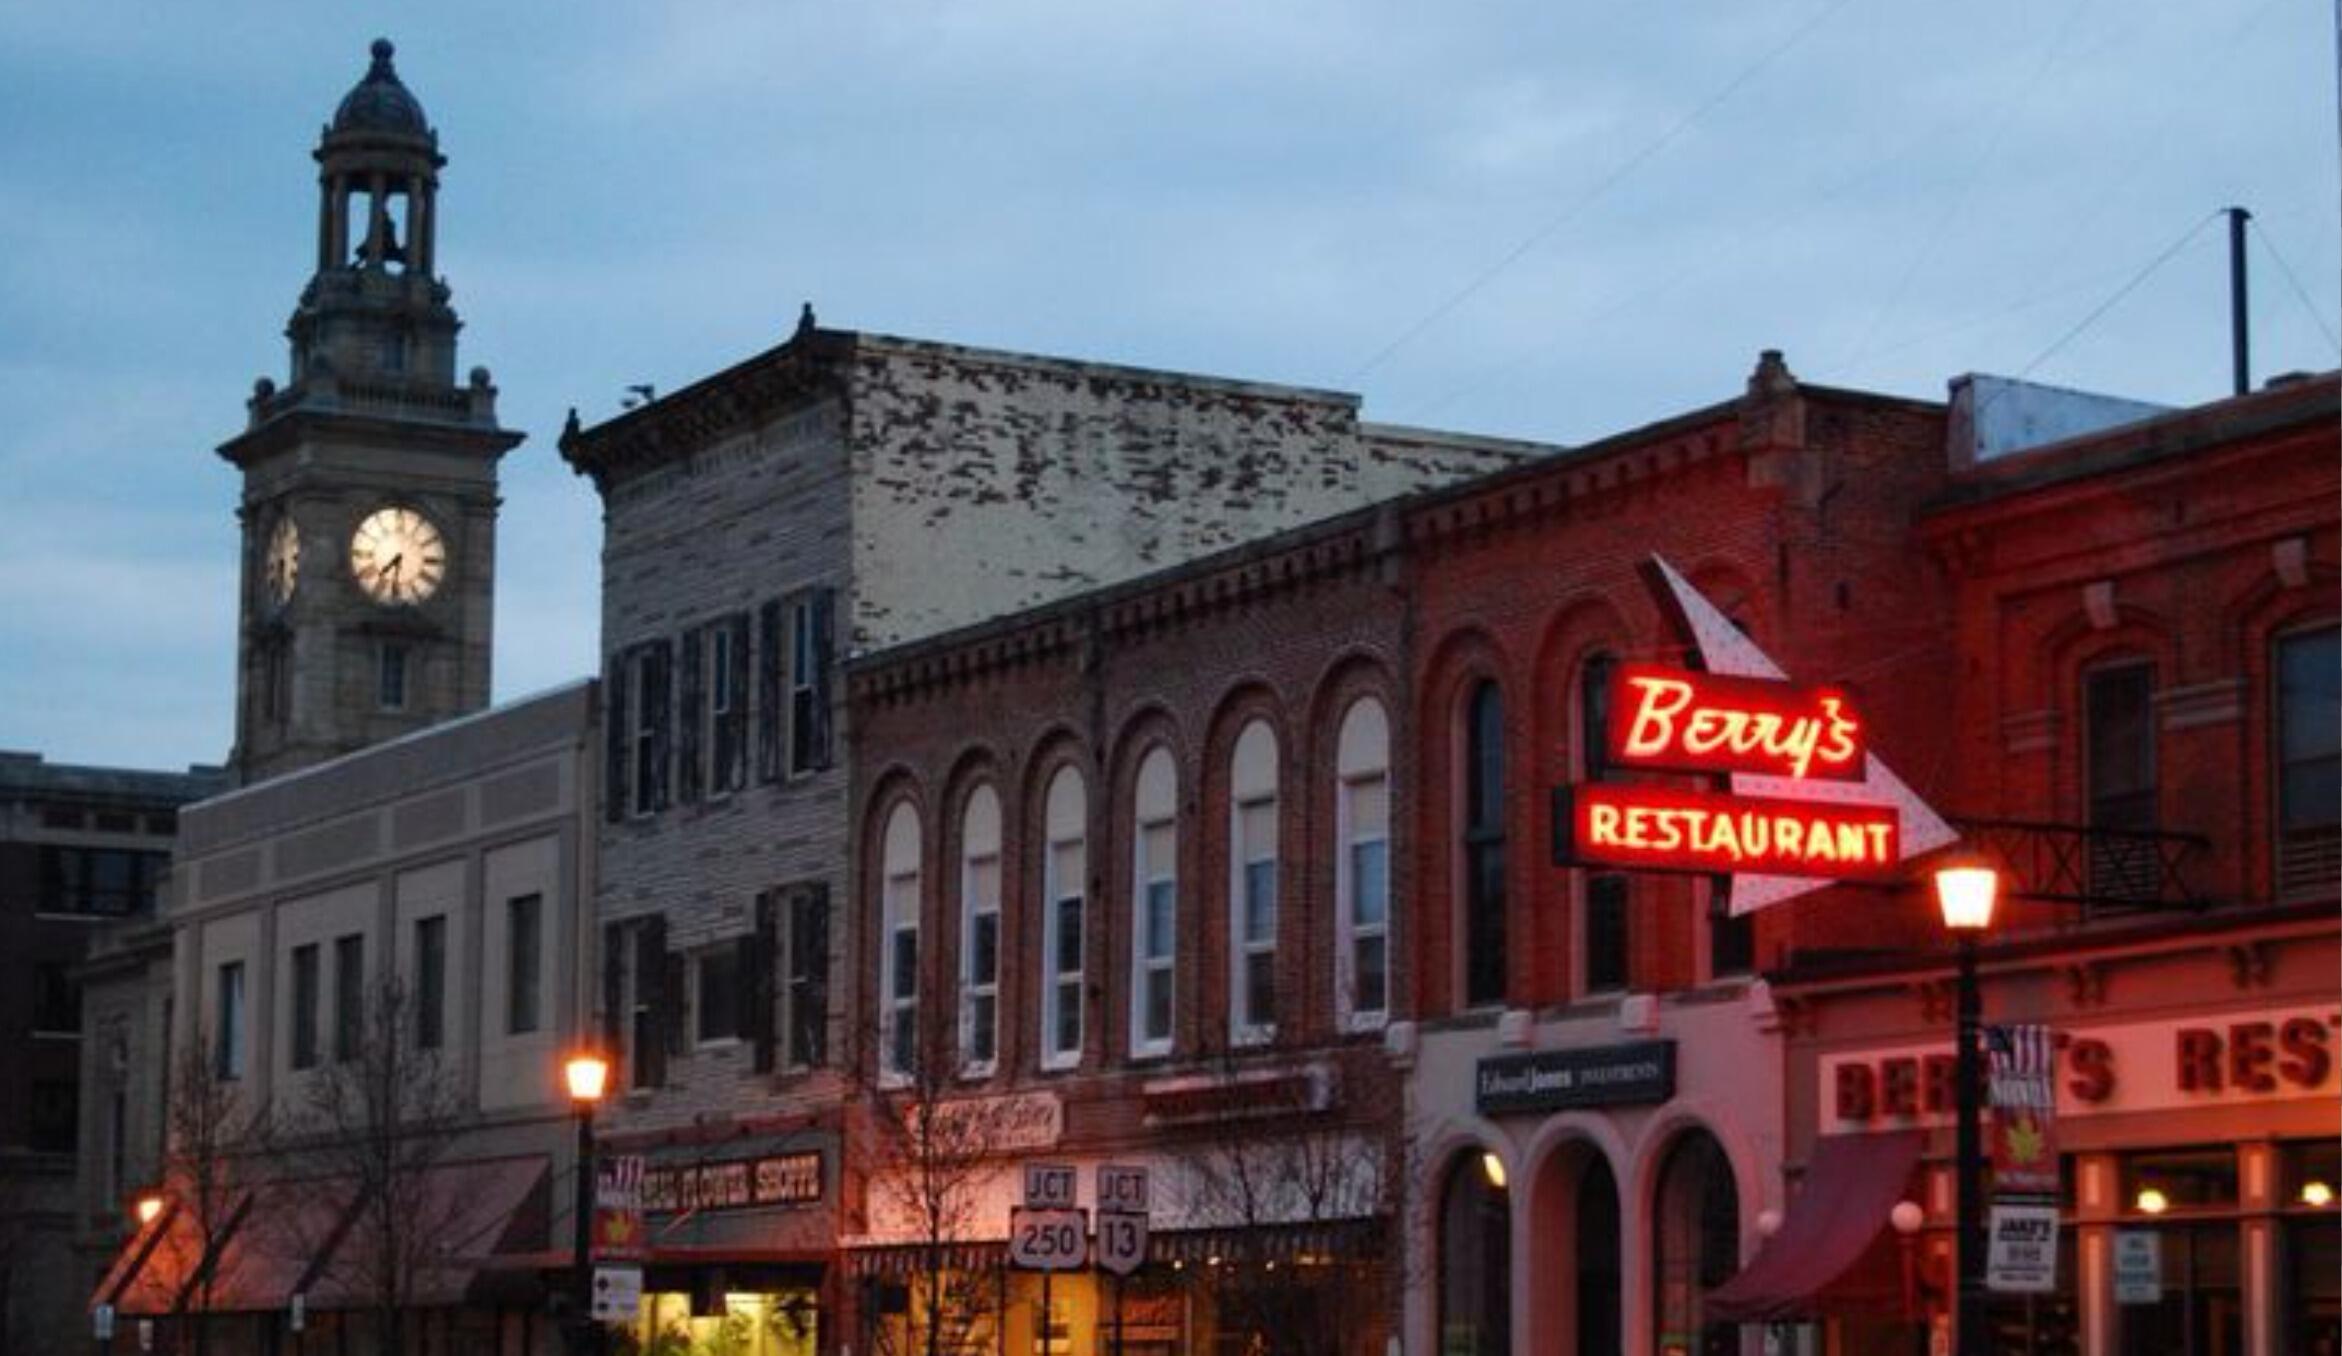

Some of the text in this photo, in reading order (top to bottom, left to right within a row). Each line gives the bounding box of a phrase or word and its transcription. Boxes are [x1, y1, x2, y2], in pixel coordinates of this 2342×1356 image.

[1623, 677, 1857, 779] Berry's
[1589, 803, 1894, 864] RESTAURANT
[1027, 1171, 1071, 1198] JCT
[1100, 1174, 1142, 1199] JCT
[1023, 1224, 1075, 1255] 250
[1105, 1221, 1137, 1258] 13
